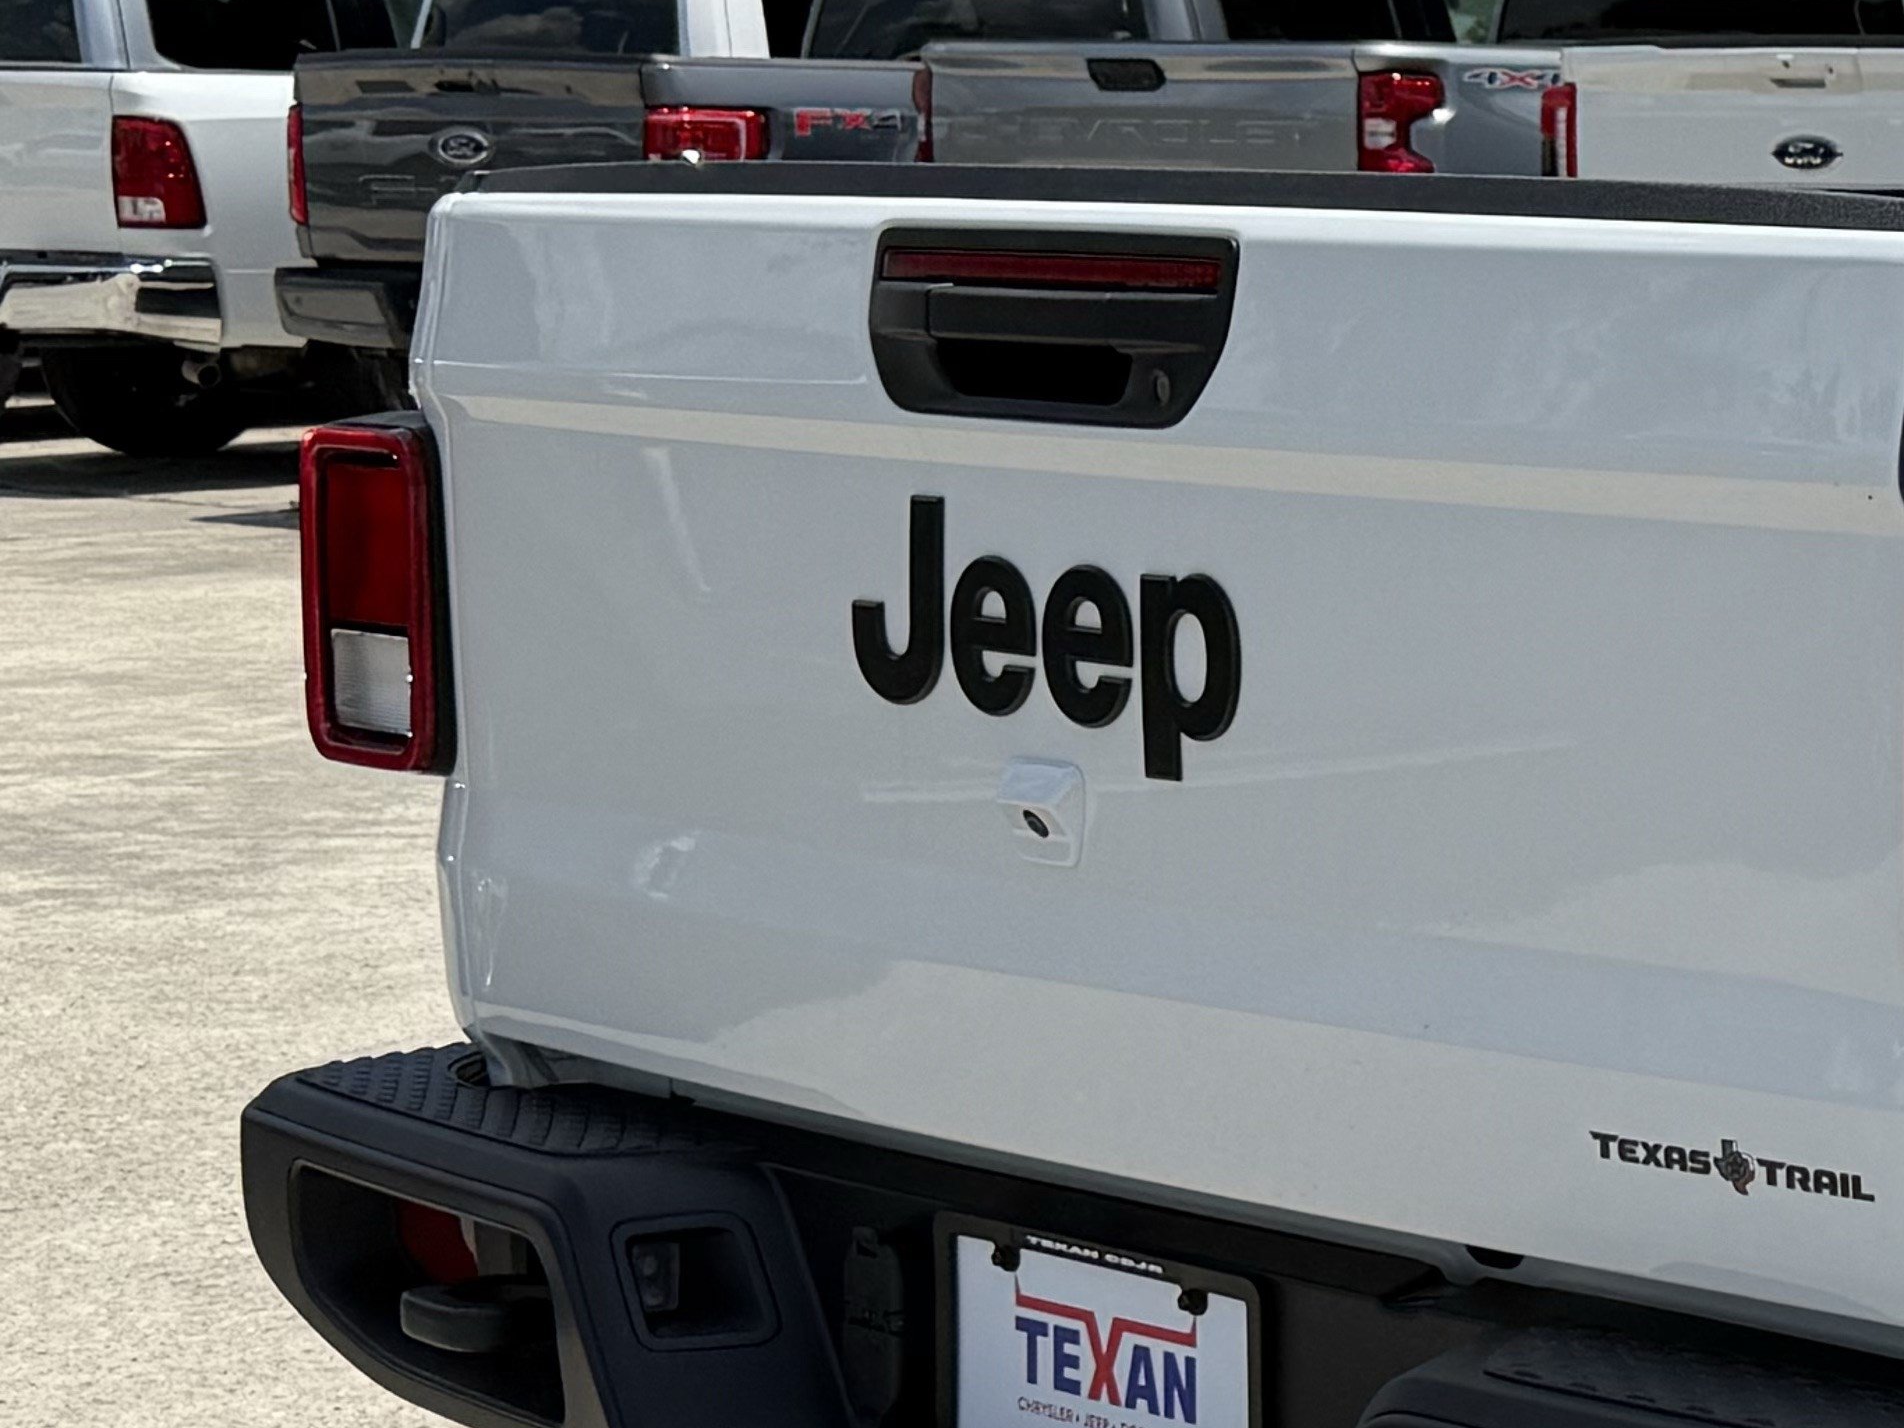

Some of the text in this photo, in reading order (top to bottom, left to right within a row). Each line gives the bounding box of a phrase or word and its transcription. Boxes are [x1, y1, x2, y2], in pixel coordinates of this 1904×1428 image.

[852, 494, 1242, 781] Jeep
[1588, 1130, 1876, 1203] TEXAS TRAIL
[1025, 1234, 1099, 1260] TEXAN
[1014, 1292, 1198, 1425] TEXAN
[1017, 1395, 1073, 1424] CHRYSLER
